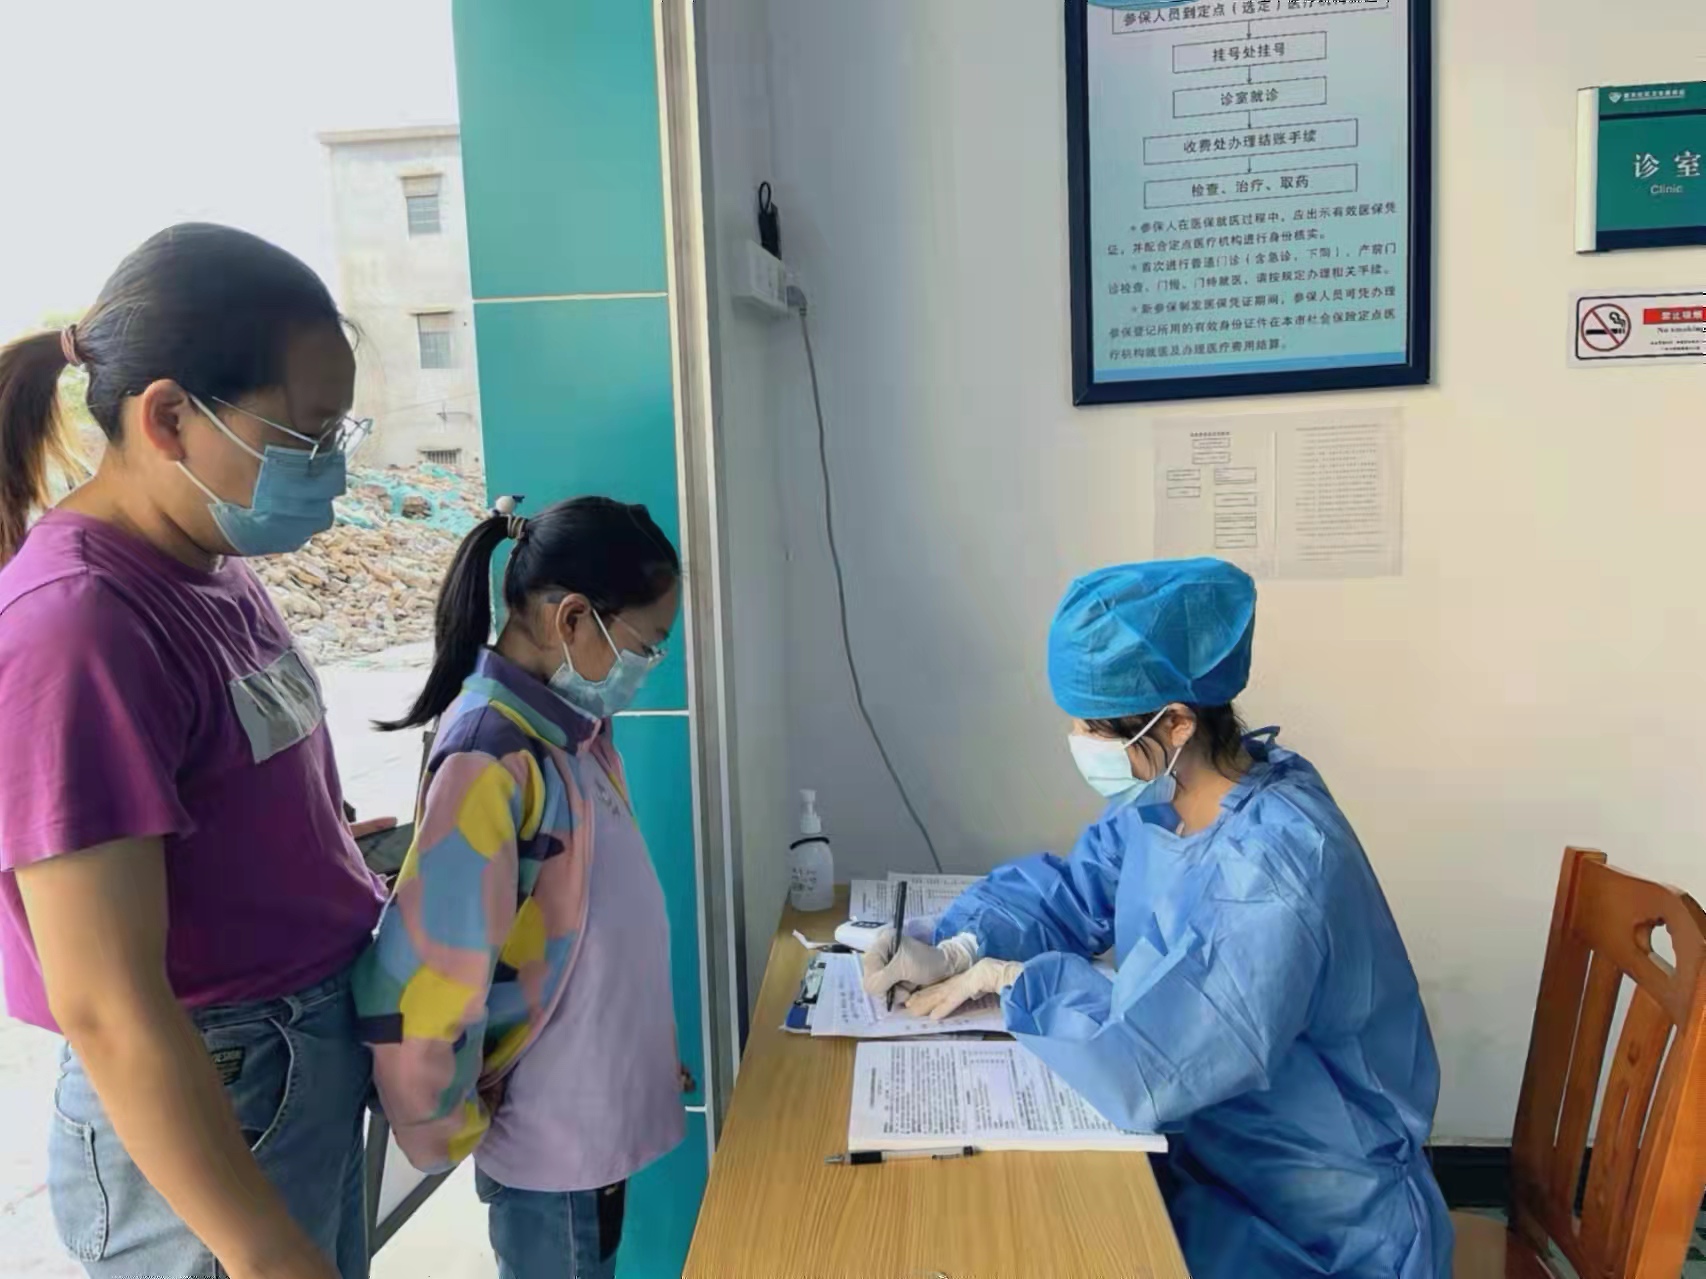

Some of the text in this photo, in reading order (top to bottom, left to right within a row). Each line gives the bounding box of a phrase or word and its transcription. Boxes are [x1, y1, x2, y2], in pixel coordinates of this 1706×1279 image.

[1212, 42, 1286, 62] 挂号处挂号
[1220, 88, 1280, 106] 诊室就诊
[1183, 129, 1317, 154] 收费处办理结账手续
[1634, 151, 1701, 179] 诊室
[1650, 184, 1683, 195] Clinic
